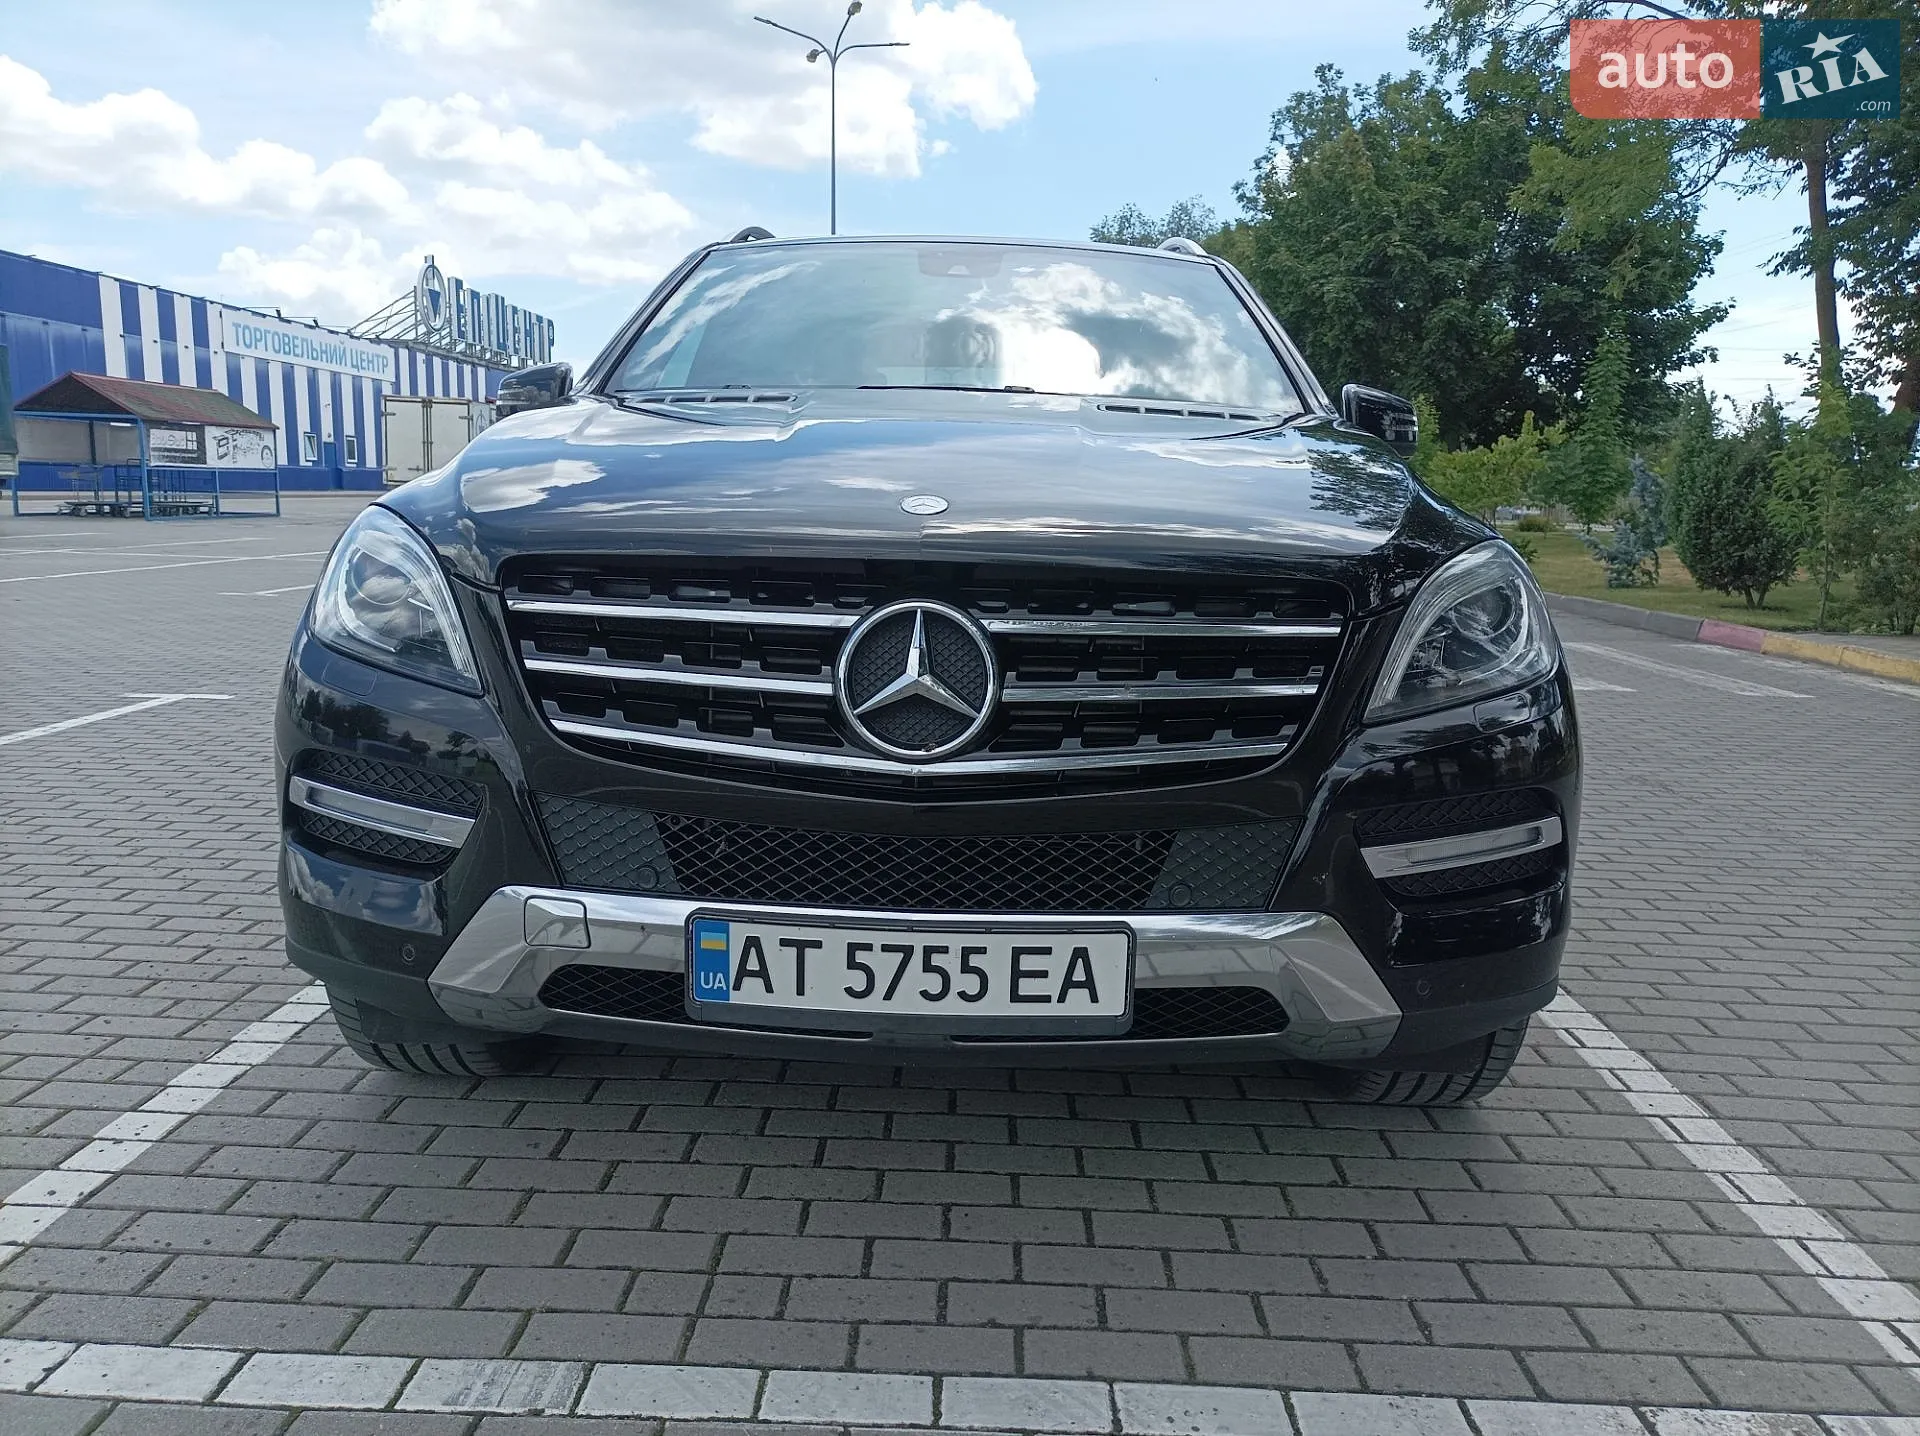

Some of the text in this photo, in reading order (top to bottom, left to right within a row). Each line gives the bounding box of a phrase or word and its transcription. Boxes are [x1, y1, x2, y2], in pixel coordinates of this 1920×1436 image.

[231, 321, 389, 375] ТОРГОВЕЛЬНИЙ ЦЕНТР
[700, 971, 727, 991] UA
[731, 935, 1099, 1004] AT 5755 EA
